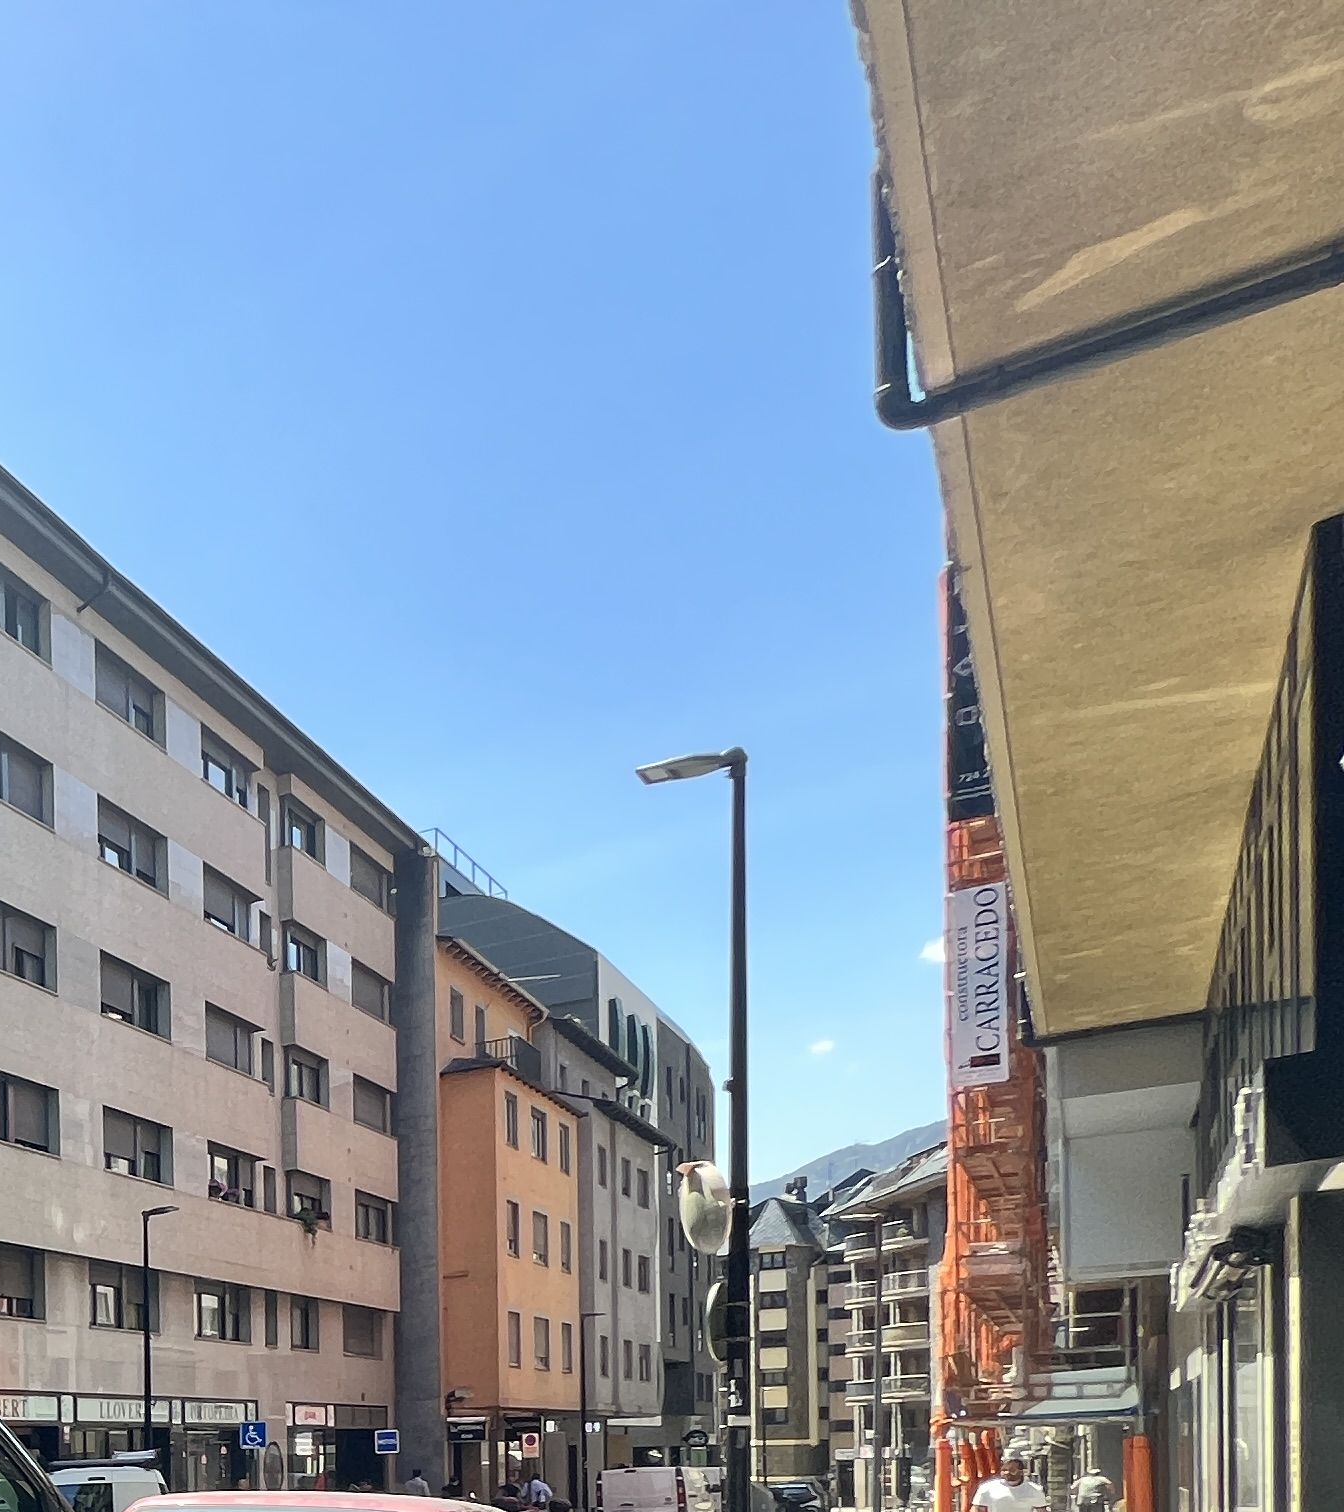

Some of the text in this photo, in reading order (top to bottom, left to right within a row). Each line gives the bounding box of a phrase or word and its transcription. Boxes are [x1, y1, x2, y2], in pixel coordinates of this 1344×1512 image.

[957, 926, 969, 1022] constructora
[973, 887, 1000, 1052] CARRACEDO
[98, 1401, 144, 1419] LLOVER
